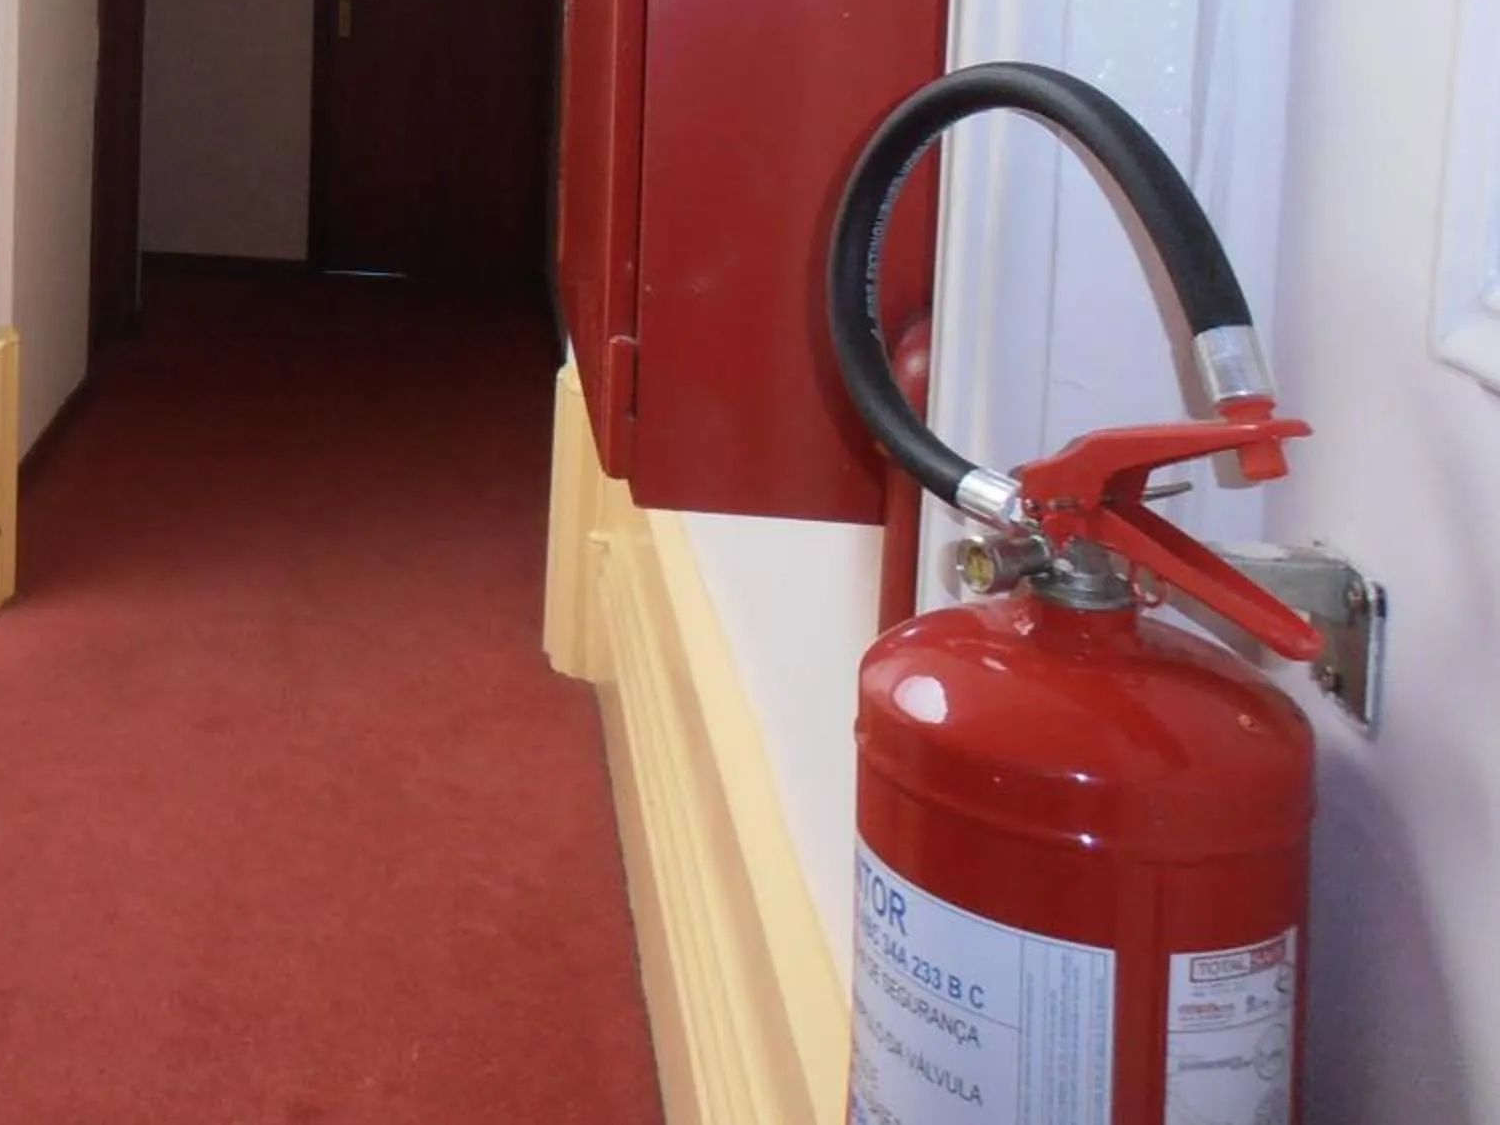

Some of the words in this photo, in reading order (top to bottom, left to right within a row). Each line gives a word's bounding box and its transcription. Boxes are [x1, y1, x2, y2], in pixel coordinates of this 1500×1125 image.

[911, 954, 942, 990] 233
[947, 973, 963, 999] B
[968, 984, 985, 1009] C
